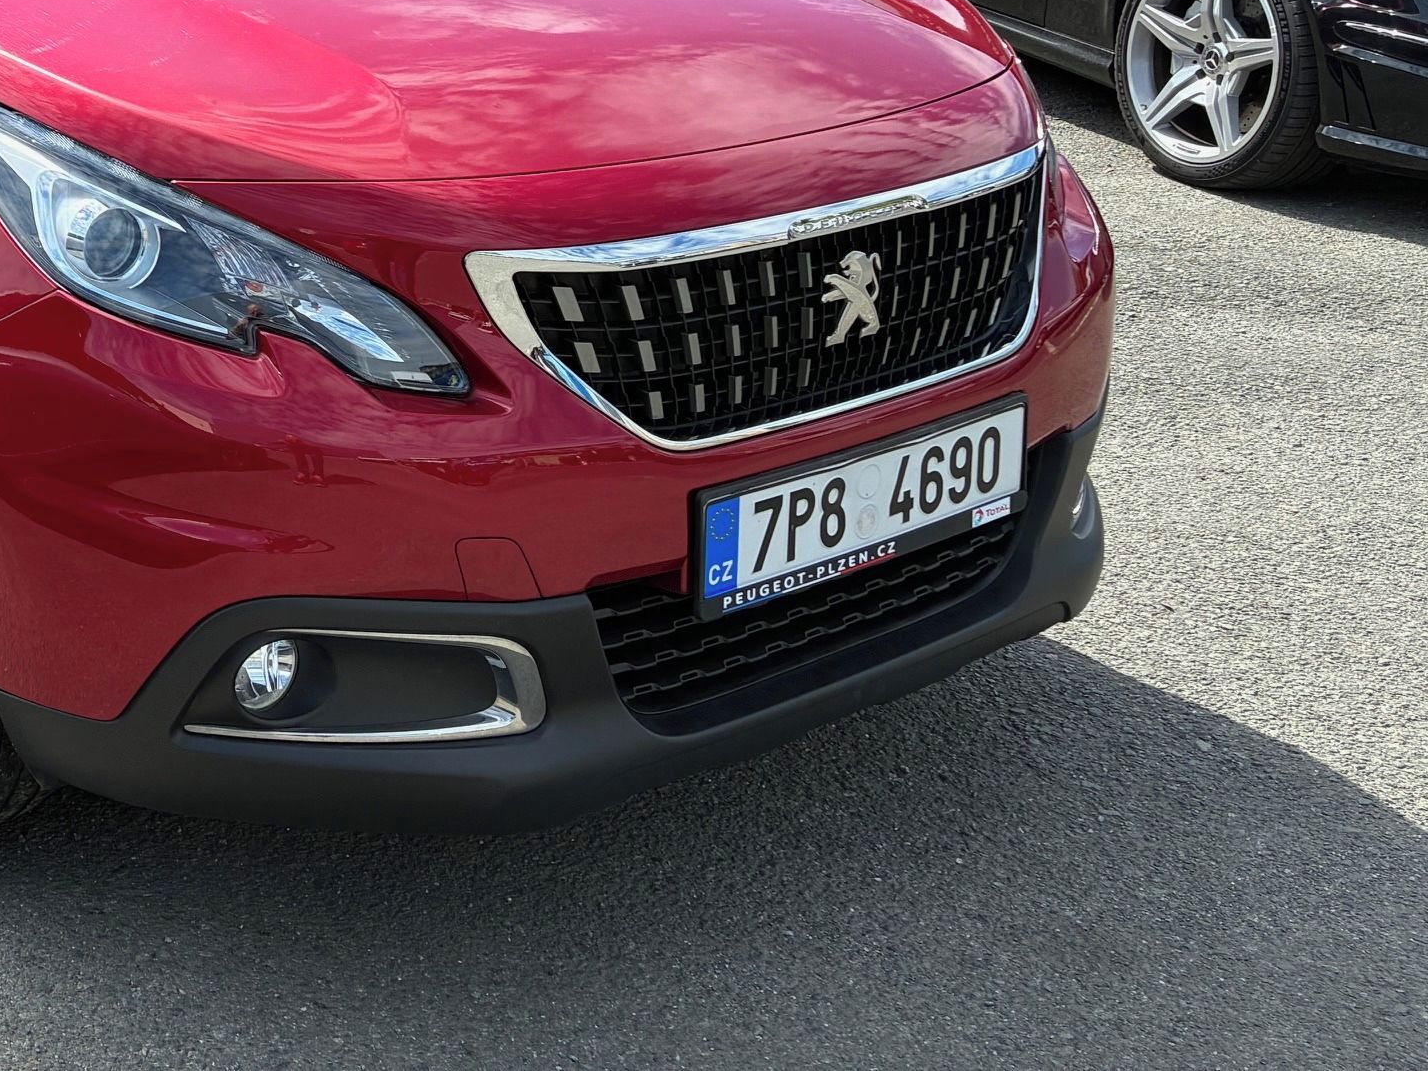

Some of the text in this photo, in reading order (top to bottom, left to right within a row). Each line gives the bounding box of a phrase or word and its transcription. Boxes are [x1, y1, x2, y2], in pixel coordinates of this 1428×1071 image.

[751, 426, 1002, 574] 7P8 4690
[708, 559, 734, 586] CZ
[722, 541, 898, 610] PEUGEOT-PLZEN.CZ
